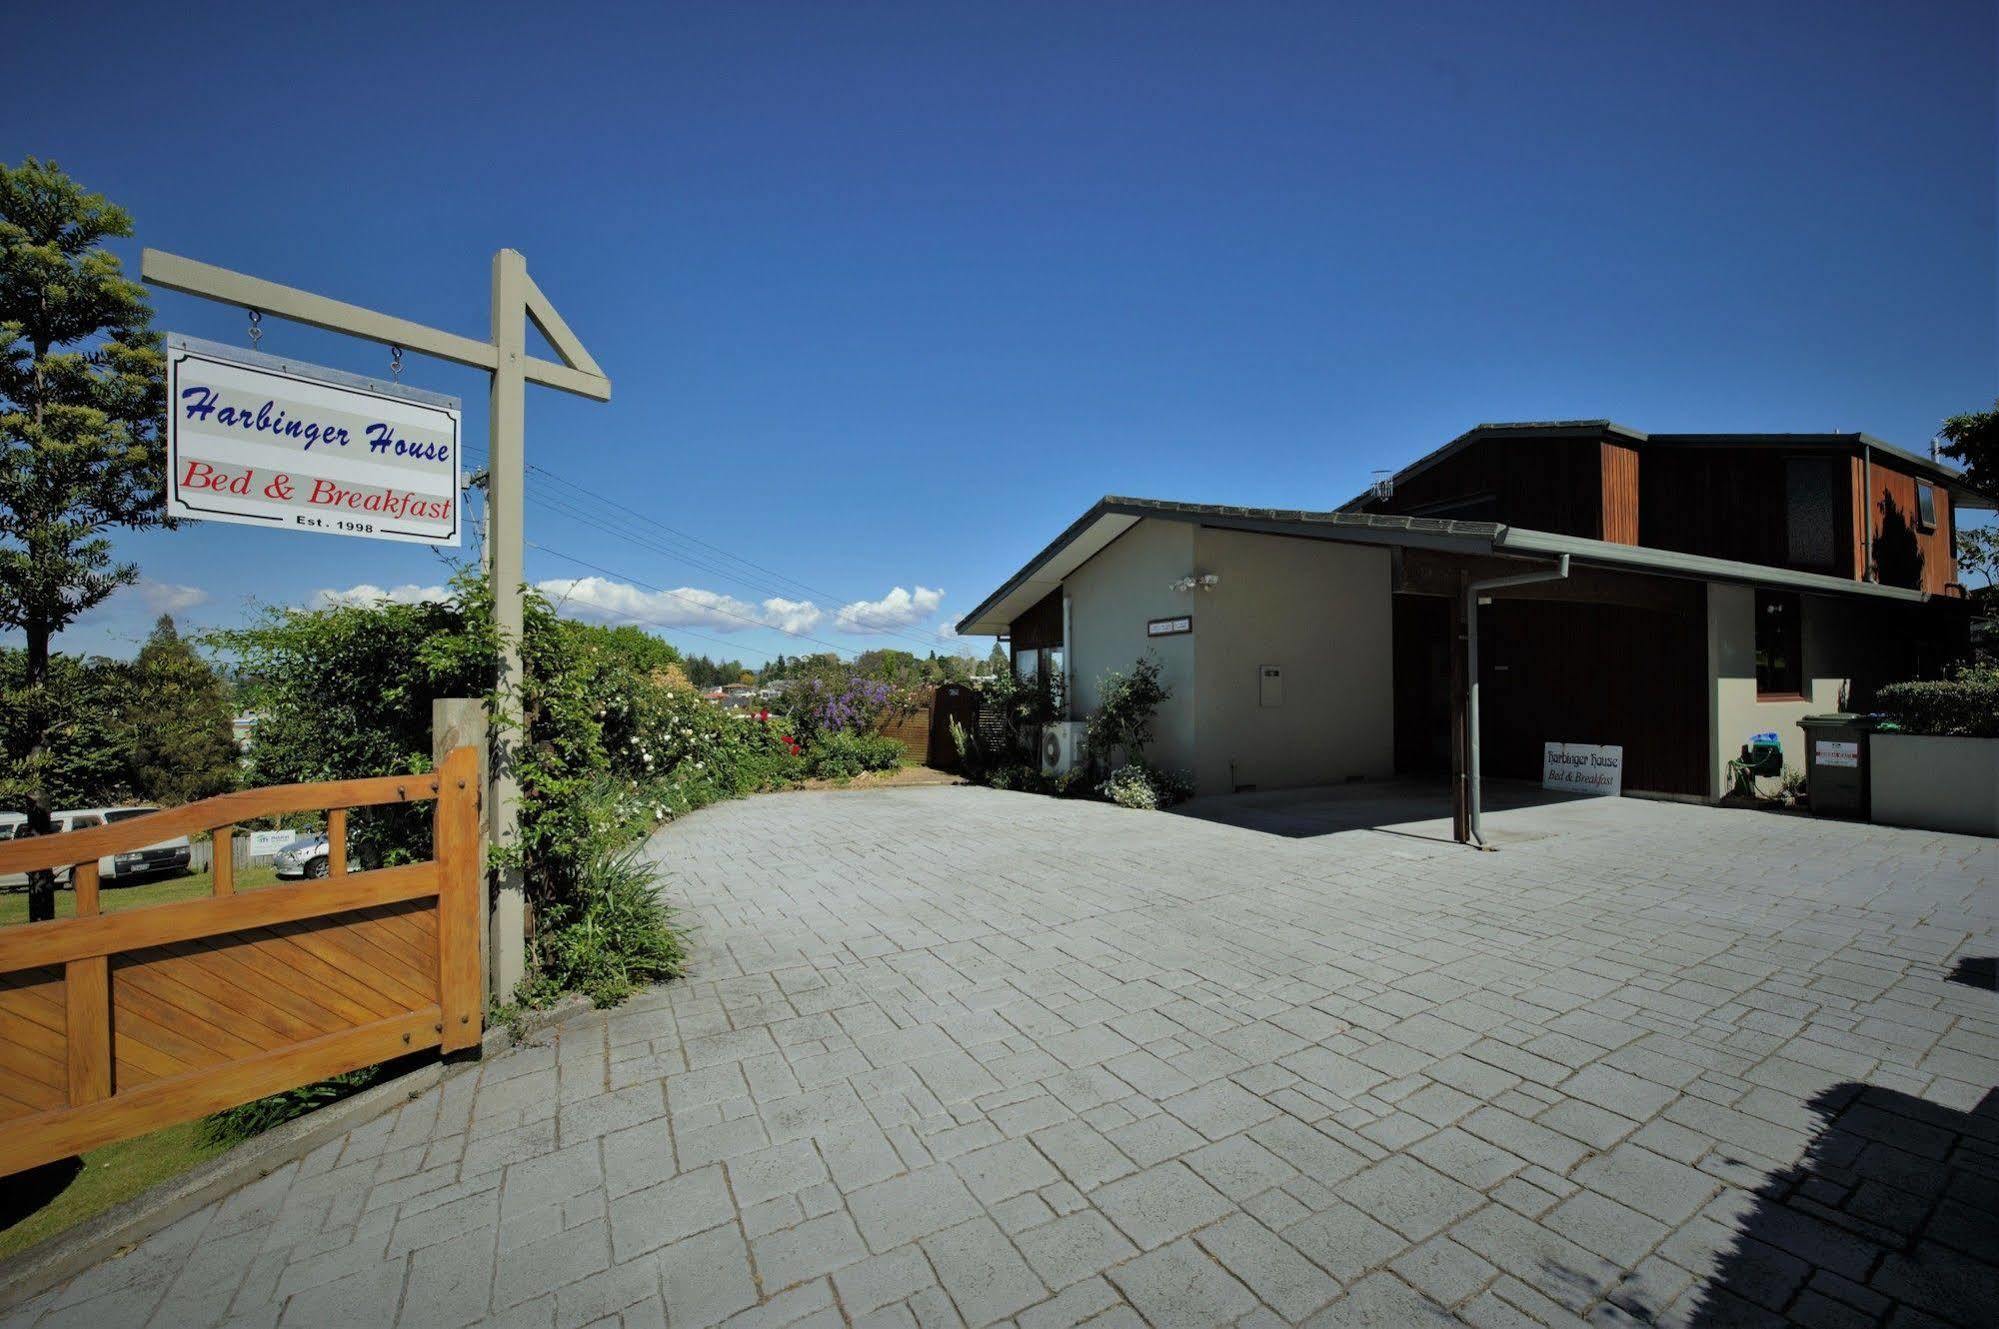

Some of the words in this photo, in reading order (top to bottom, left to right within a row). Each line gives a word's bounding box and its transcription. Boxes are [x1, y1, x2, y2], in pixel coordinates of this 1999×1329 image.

[182, 386, 351, 451] Harbinger
[365, 423, 449, 462] House
[180, 461, 254, 495] Bed
[264, 474, 295, 500] &
[307, 479, 452, 520] Breakfast
[296, 515, 330, 528] Est.
[337, 521, 374, 534] 1998
[1548, 769, 1565, 782] Bed
[1565, 772, 1573, 782] &
[1575, 772, 1614, 787] Breakfast
